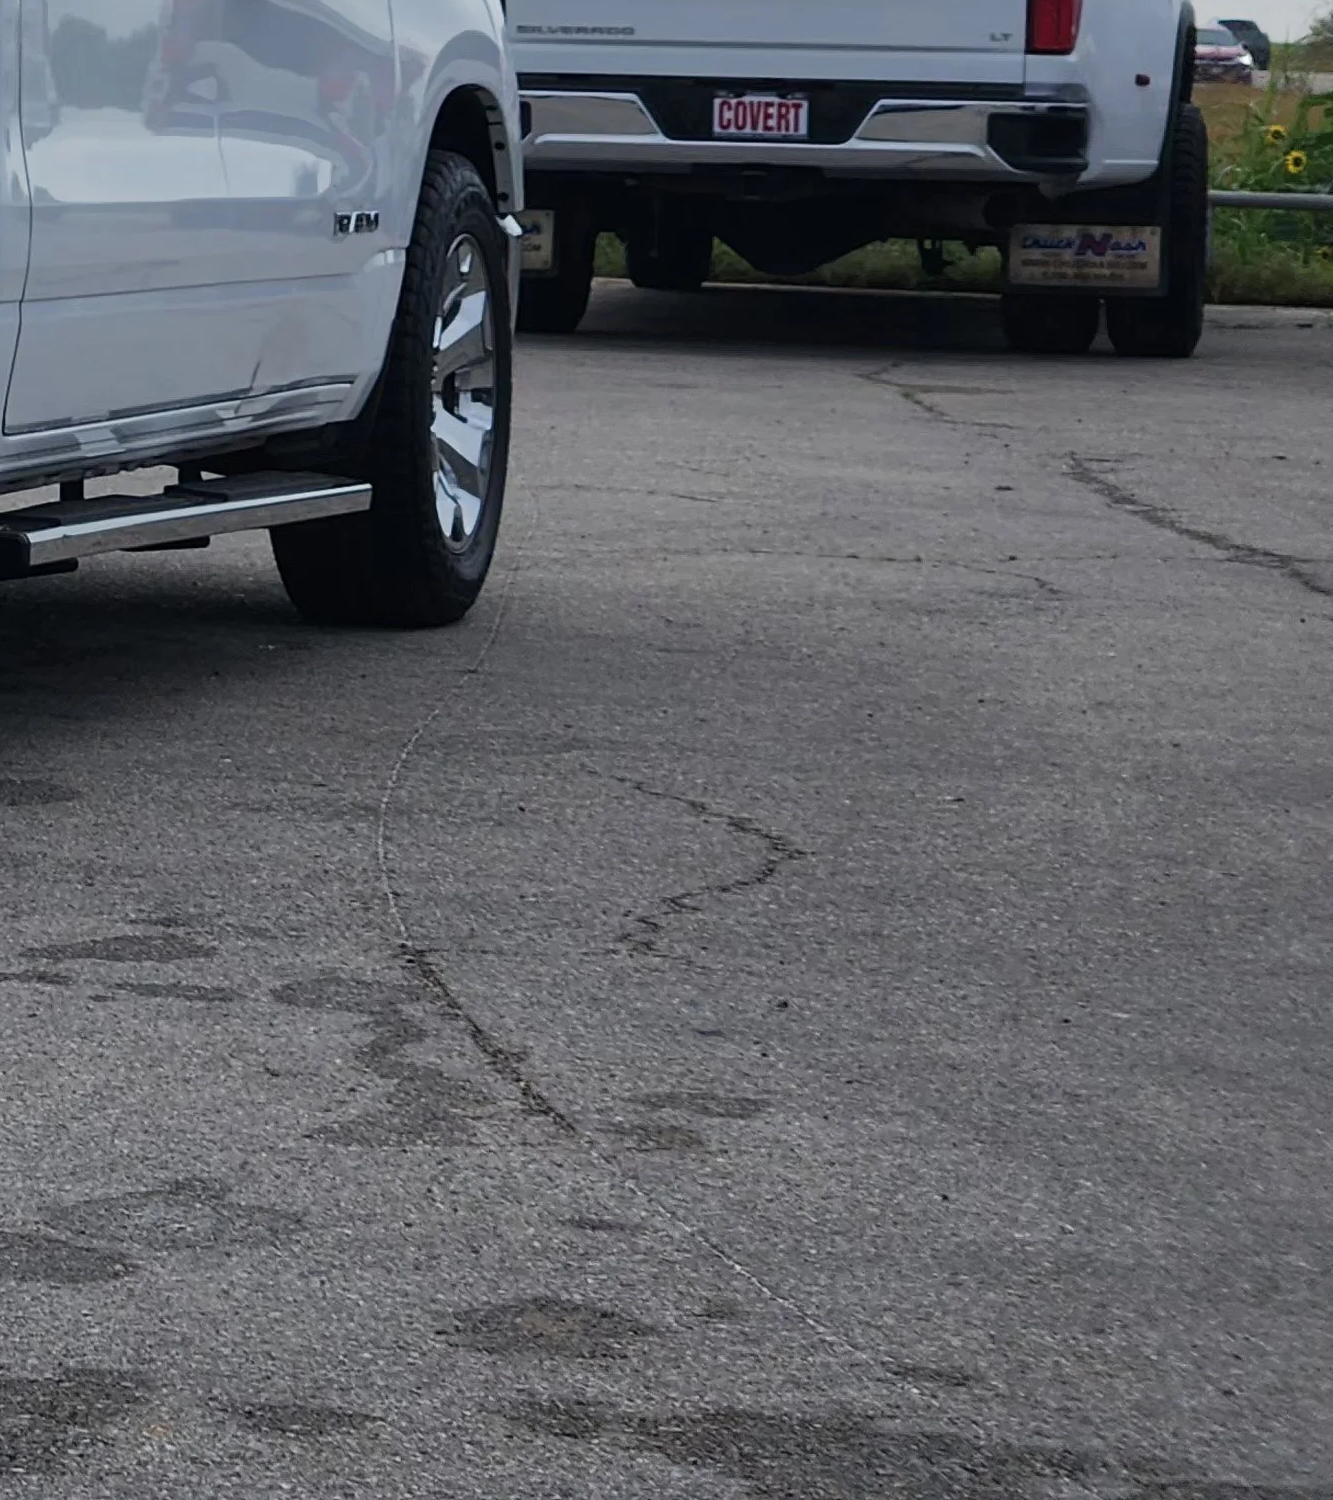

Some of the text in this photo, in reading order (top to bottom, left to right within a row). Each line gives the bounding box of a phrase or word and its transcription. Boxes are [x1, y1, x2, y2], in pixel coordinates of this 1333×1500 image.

[988, 31, 1014, 42] LT
[718, 99, 803, 133] COVERT
[333, 210, 380, 236] RAM
